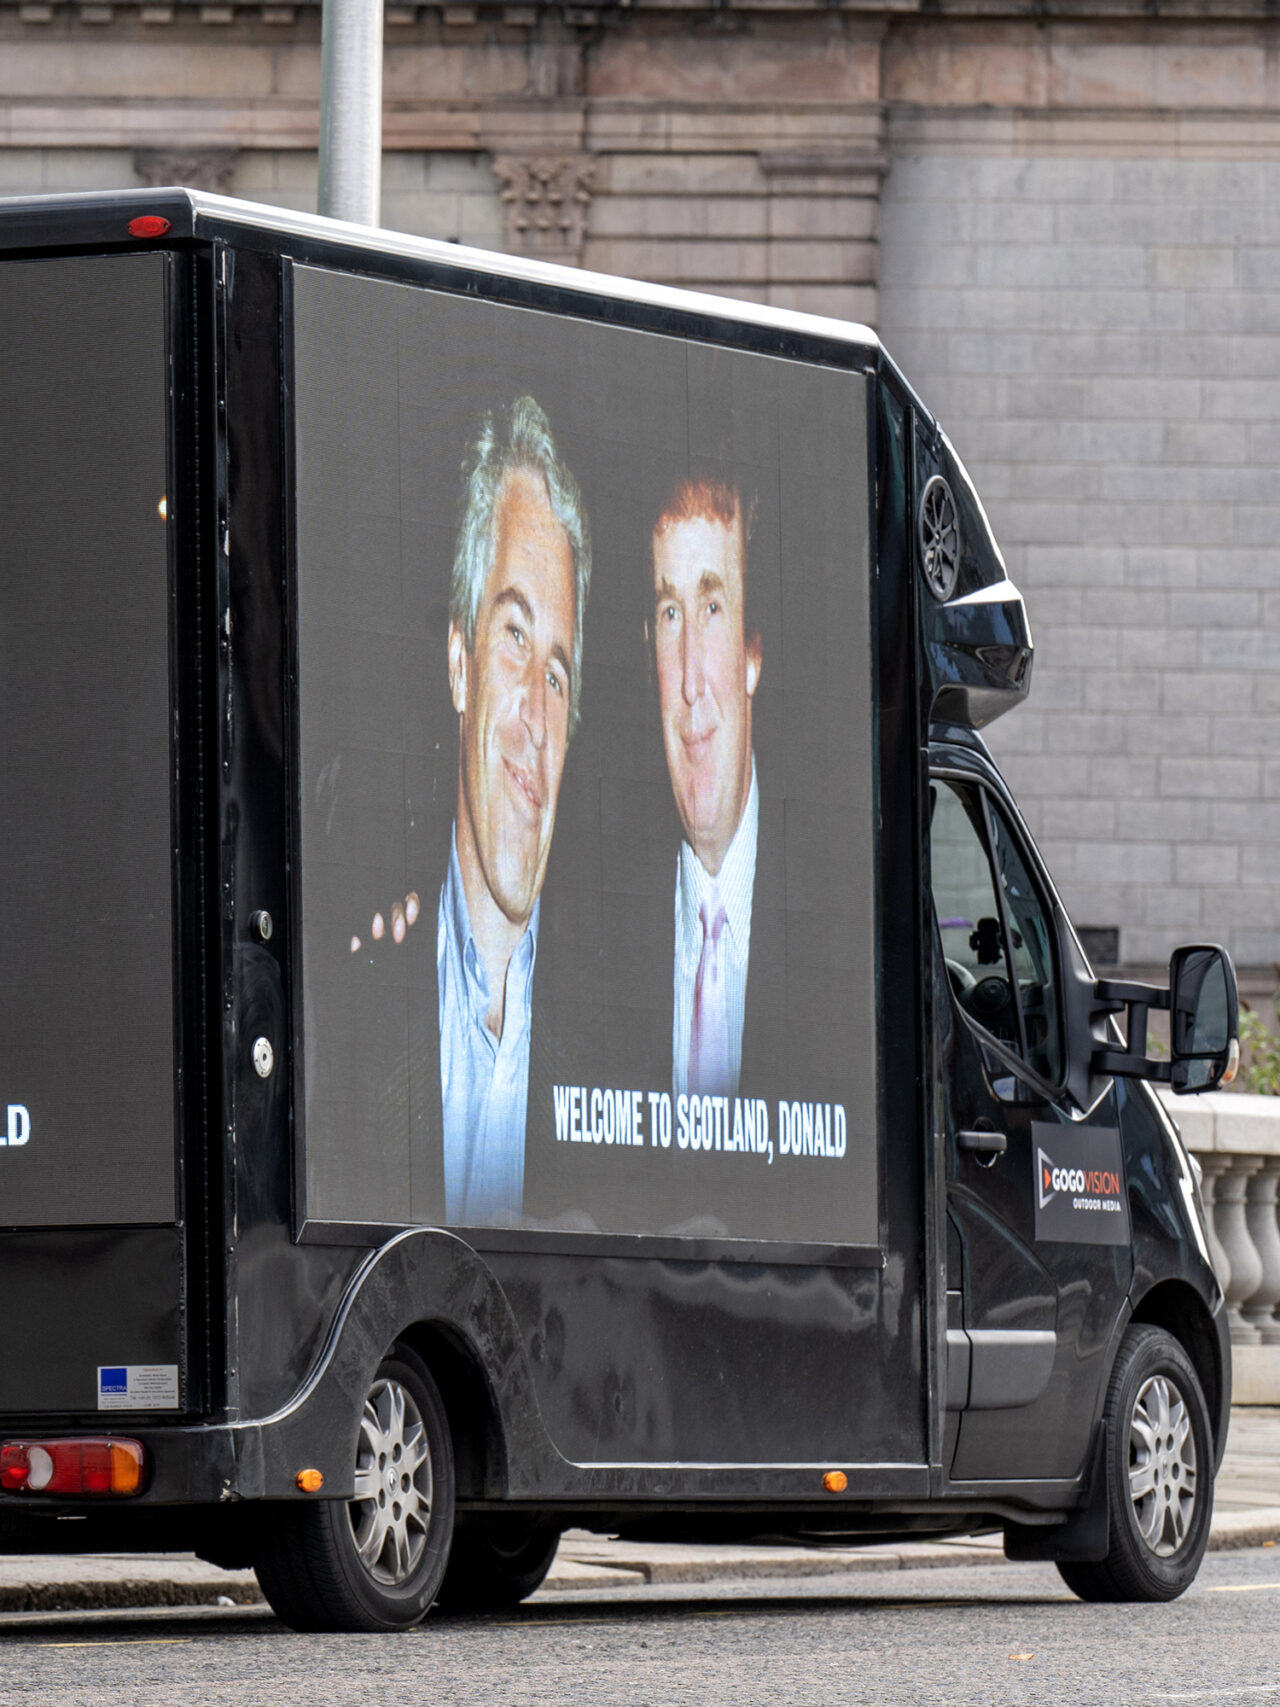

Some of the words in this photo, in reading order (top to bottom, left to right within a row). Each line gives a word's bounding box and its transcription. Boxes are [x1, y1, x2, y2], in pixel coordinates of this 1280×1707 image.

[552, 1085, 643, 1146] WELCOME
[647, 1091, 672, 1148] TO
[677, 1093, 773, 1164] SCOTLAND,
[778, 1100, 847, 1158] DONALD
[1052, 1167, 1120, 1195] GOGOVISION
[1073, 1198, 1102, 1210] OUTDOOR
[1102, 1199, 1121, 1212] MEDIA
